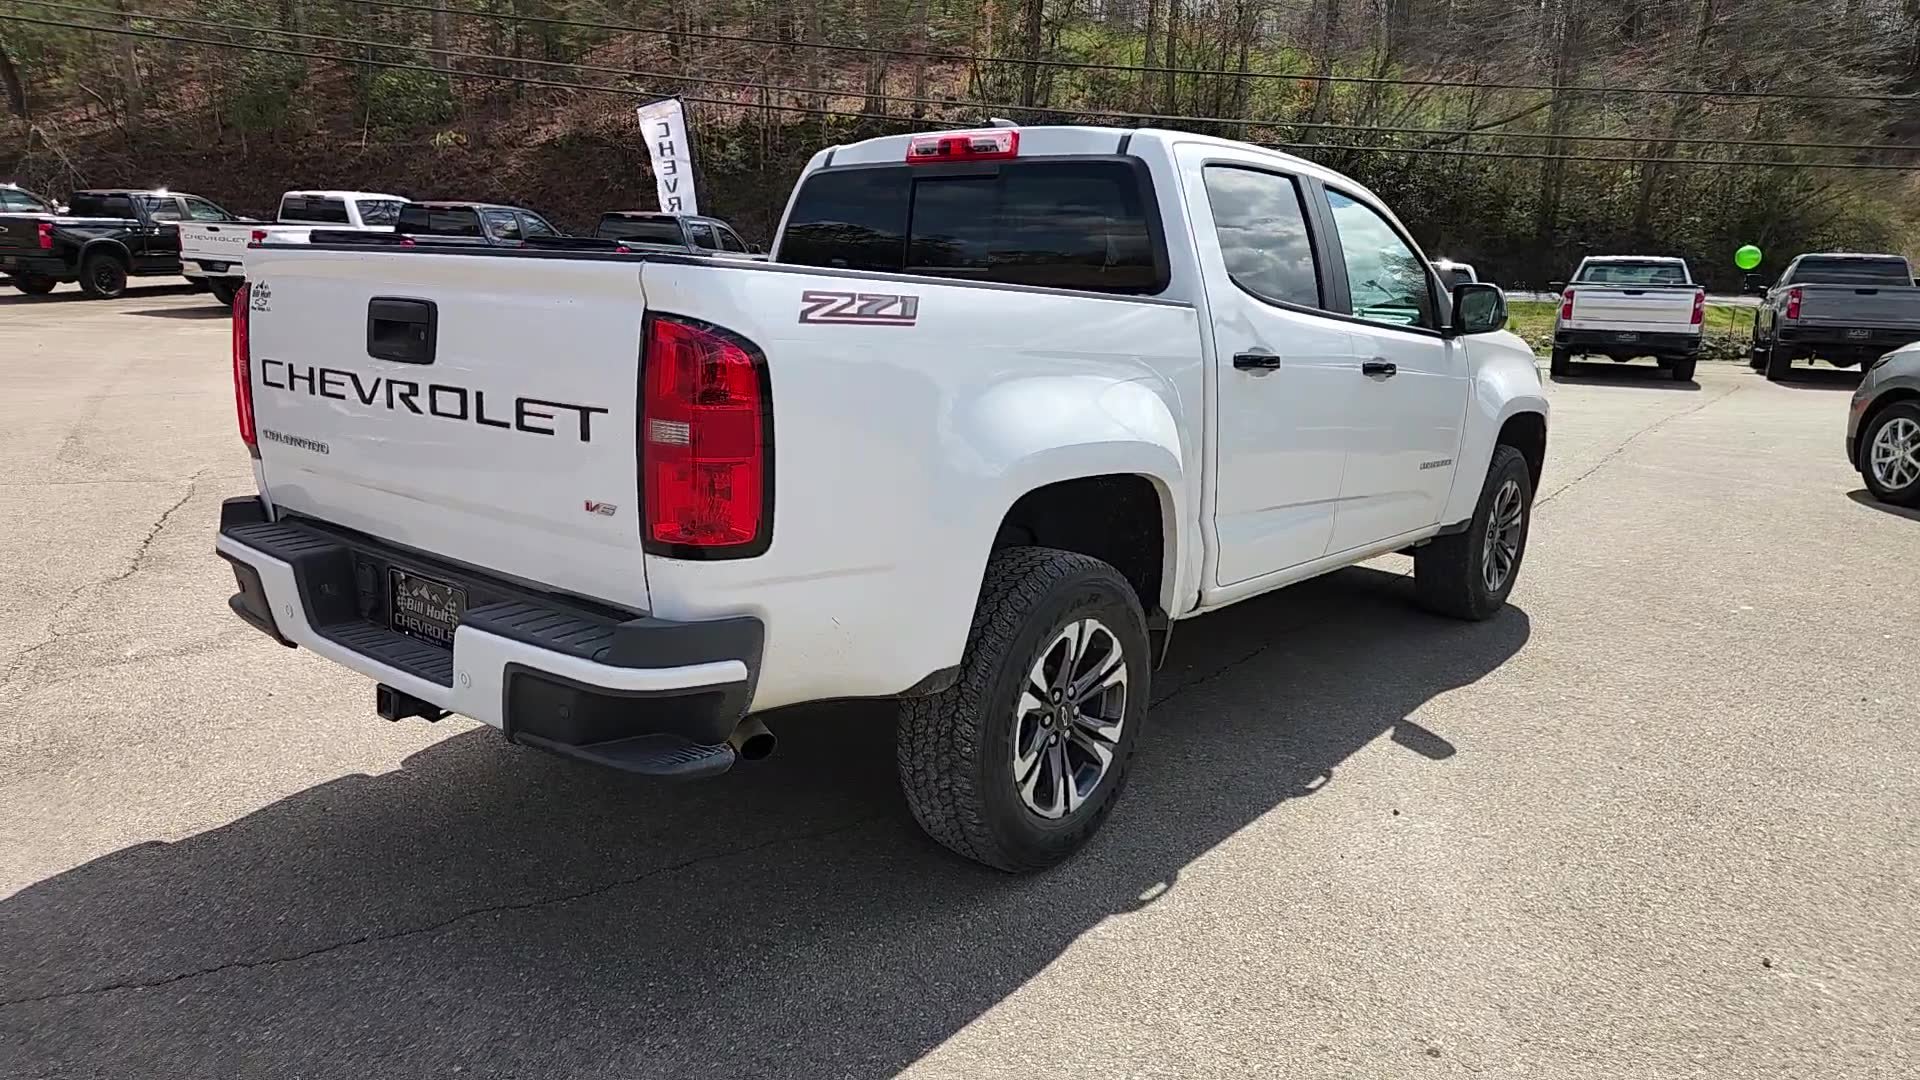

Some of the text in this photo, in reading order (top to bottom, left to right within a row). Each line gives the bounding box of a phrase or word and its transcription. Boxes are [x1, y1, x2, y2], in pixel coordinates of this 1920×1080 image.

[184, 233, 246, 243] CHEVROLET
[798, 290, 920, 327] Z71
[261, 359, 609, 442] CHEVROLET
[406, 598, 450, 622] Bill Holt
[395, 612, 454, 641] CHEVROLE
